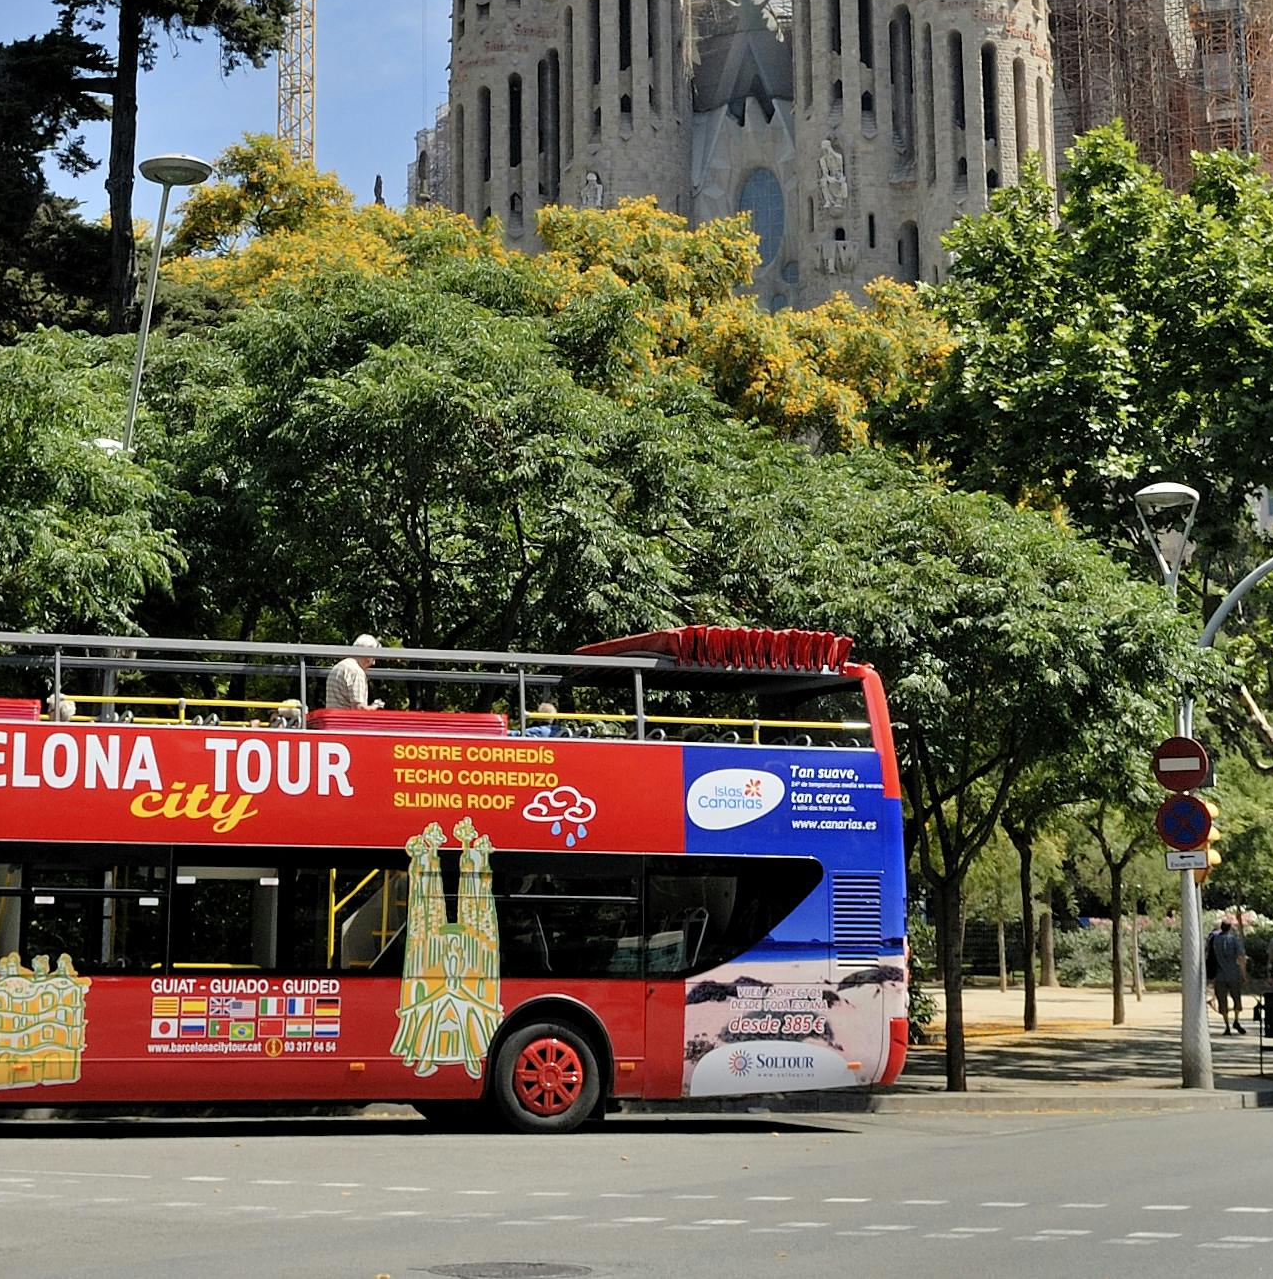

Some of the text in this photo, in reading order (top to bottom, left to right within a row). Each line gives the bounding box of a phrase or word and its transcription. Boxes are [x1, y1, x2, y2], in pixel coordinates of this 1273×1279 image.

[393, 744, 555, 764] SOSTRE CORREDÍS
[205, 737, 354, 796] TOUR
[790, 764, 859, 782] Tan suave,
[393, 768, 559, 788] TECHO CORREDIZO
[714, 785, 743, 797] Islas
[791, 791, 850, 804] tan cerca
[130, 781, 259, 834] city
[393, 792, 516, 810] SLIDING ROOF
[698, 795, 763, 810] Canarias
[792, 817, 877, 830] www.canarias.es
[151, 978, 196, 994] GUIAT
[210, 979, 269, 994] GUIADO
[283, 979, 340, 994] GUIDED
[775, 987, 823, 998] DIRECTOS
[731, 999, 761, 1010] DESDE
[764, 999, 790, 1010] TODA
[729, 1016, 780, 1033] desde
[782, 1016, 812, 1033] 385
[147, 1041, 262, 1054] www.barcelonacitytour.cat
